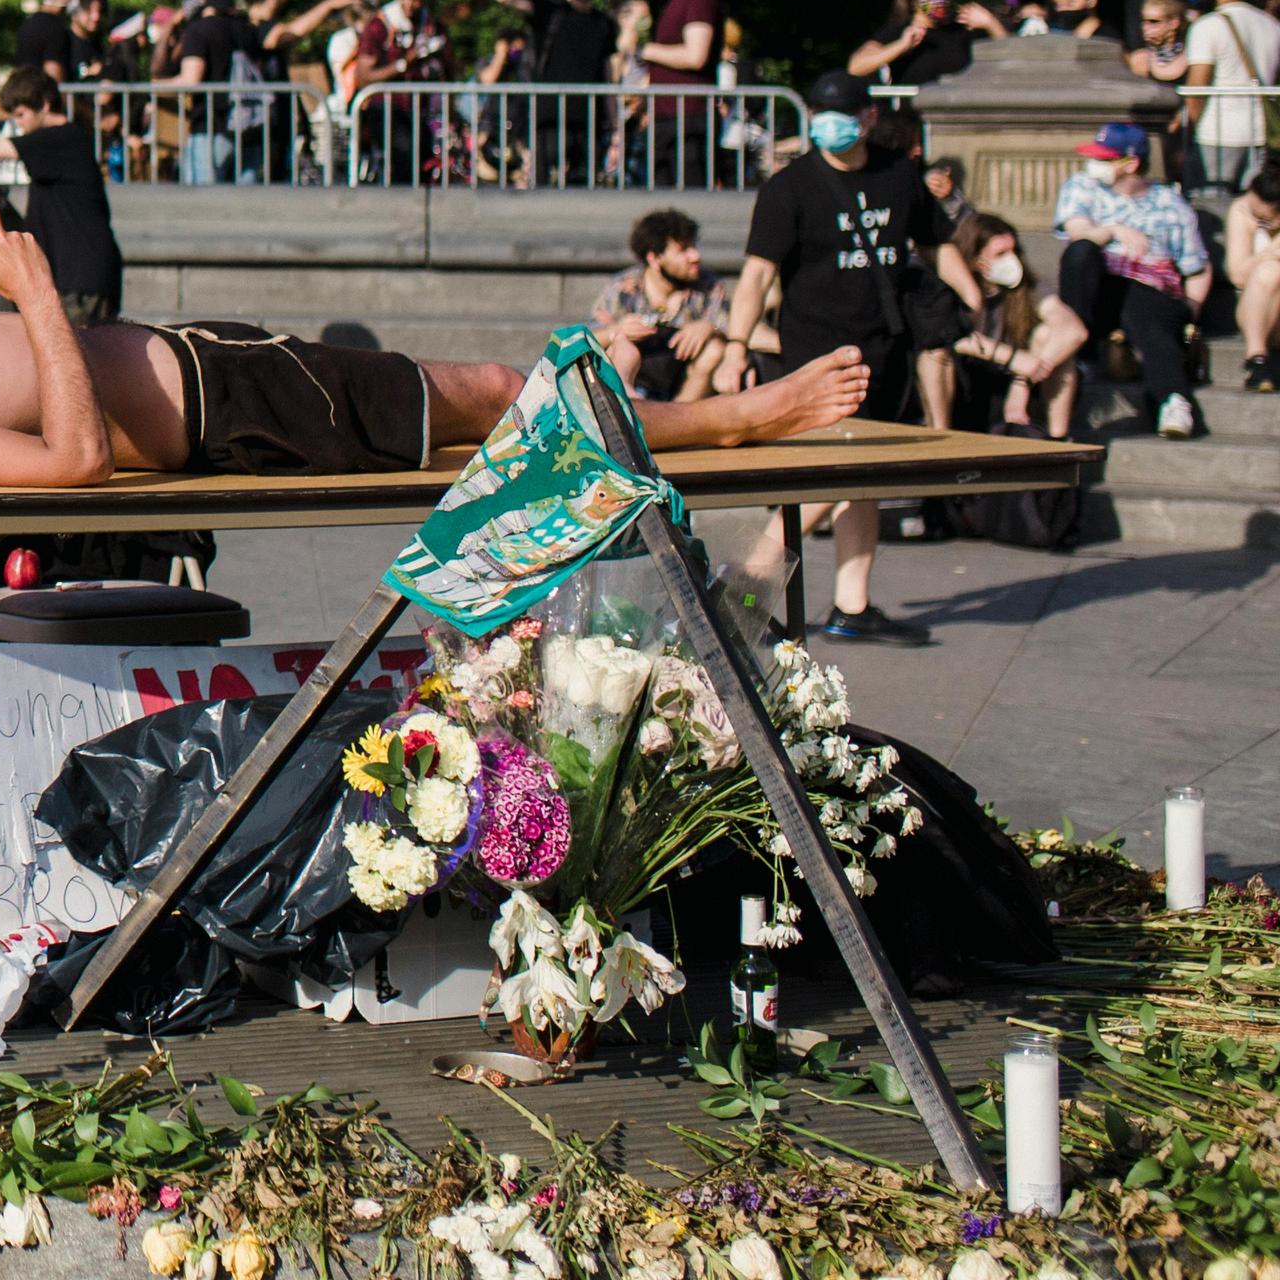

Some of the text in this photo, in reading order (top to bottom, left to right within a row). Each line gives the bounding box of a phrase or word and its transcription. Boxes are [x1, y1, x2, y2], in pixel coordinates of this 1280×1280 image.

[857, 191, 867, 210] I
[837, 207, 891, 231] KOW
[837, 246, 898, 269] RIGTS
